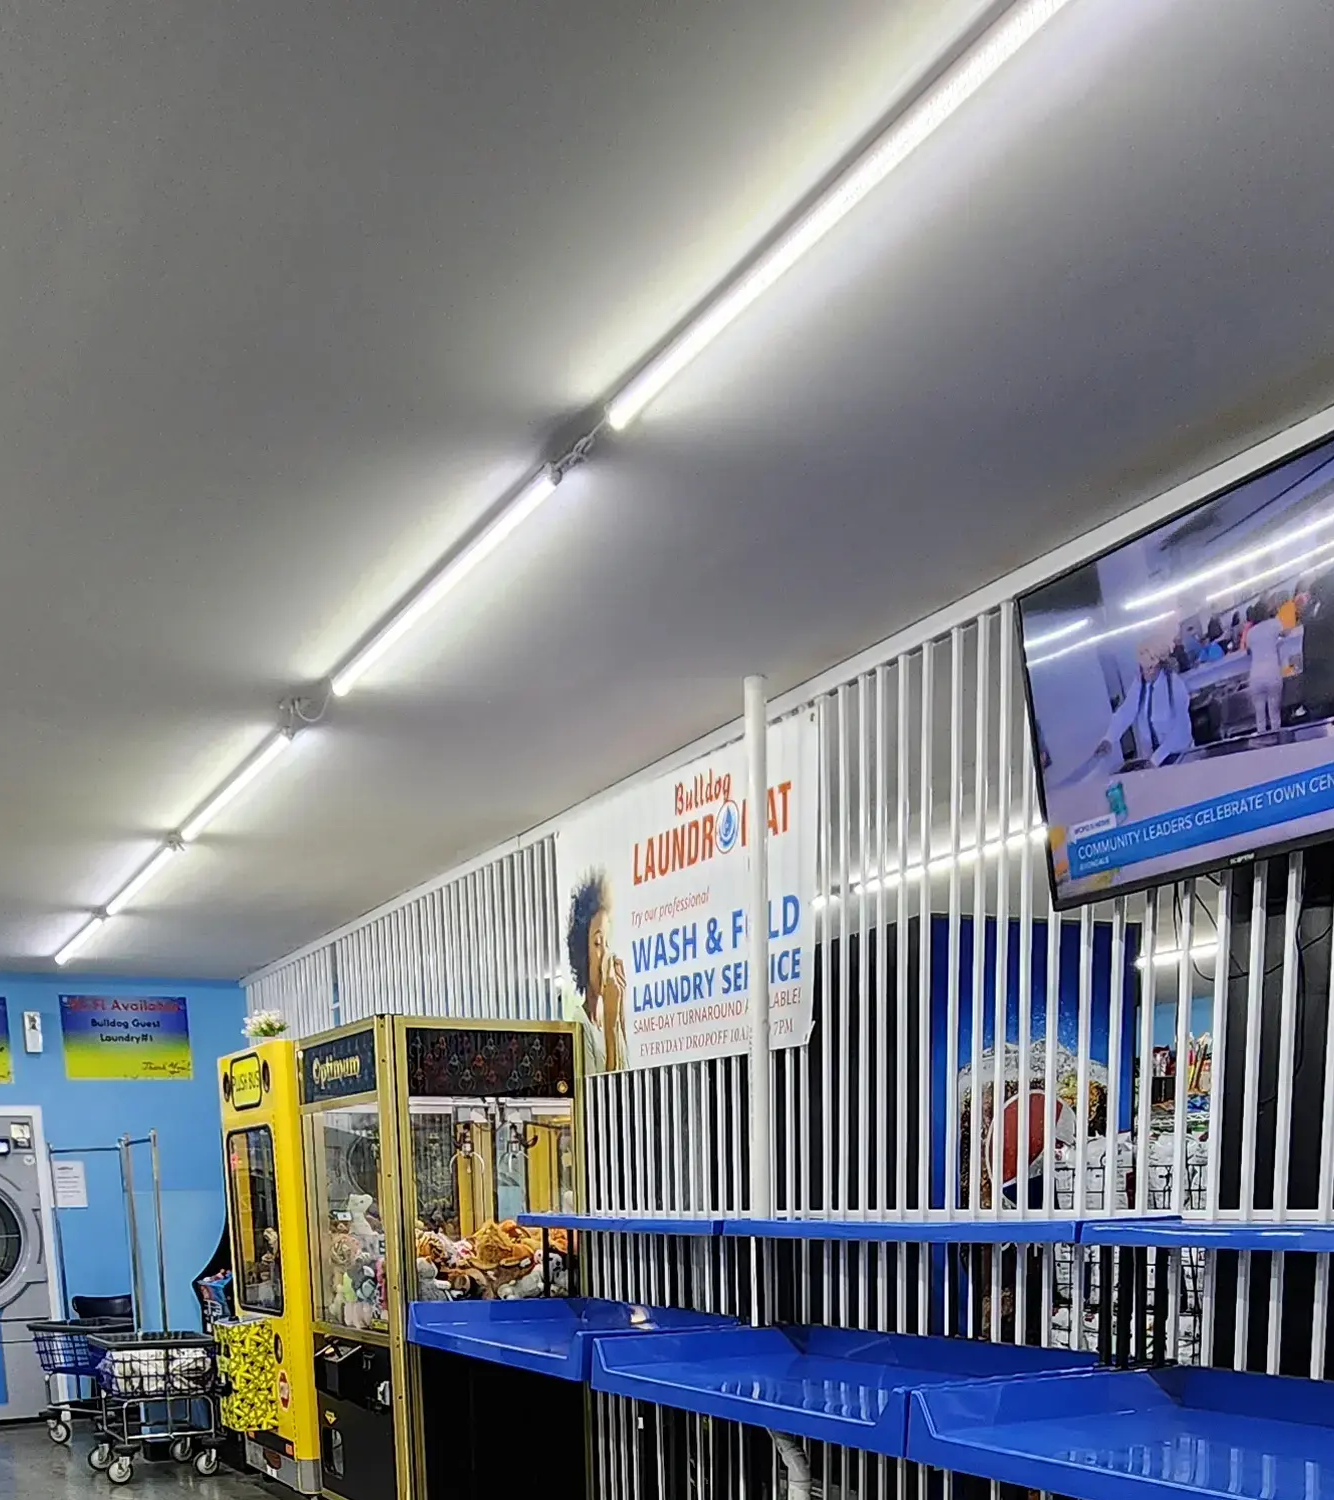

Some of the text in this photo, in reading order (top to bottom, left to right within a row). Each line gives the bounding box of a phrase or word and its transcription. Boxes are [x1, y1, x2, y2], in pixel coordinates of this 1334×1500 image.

[674, 767, 731, 816] Bulldog
[1077, 830, 1142, 860] COMMUNITY
[1143, 816, 1192, 842] LEADERS
[1194, 793, 1264, 827] CELEBRATE
[1267, 783, 1306, 806] TOWN
[631, 886, 710, 928] Try our professional
[632, 894, 800, 973] WASH & FLD
[633, 967, 715, 1012] LAUNDRY
[91, 1018, 161, 1029] Bulldog Guest
[633, 1011, 675, 1035] SAME-DAY
[677, 1000, 742, 1026] TURNAROUND
[640, 1036, 685, 1057] EVERYDAY
[685, 1029, 728, 1048] DROPOFF
[773, 1018, 794, 1035] 7PM
[312, 1054, 361, 1090] Optimum
